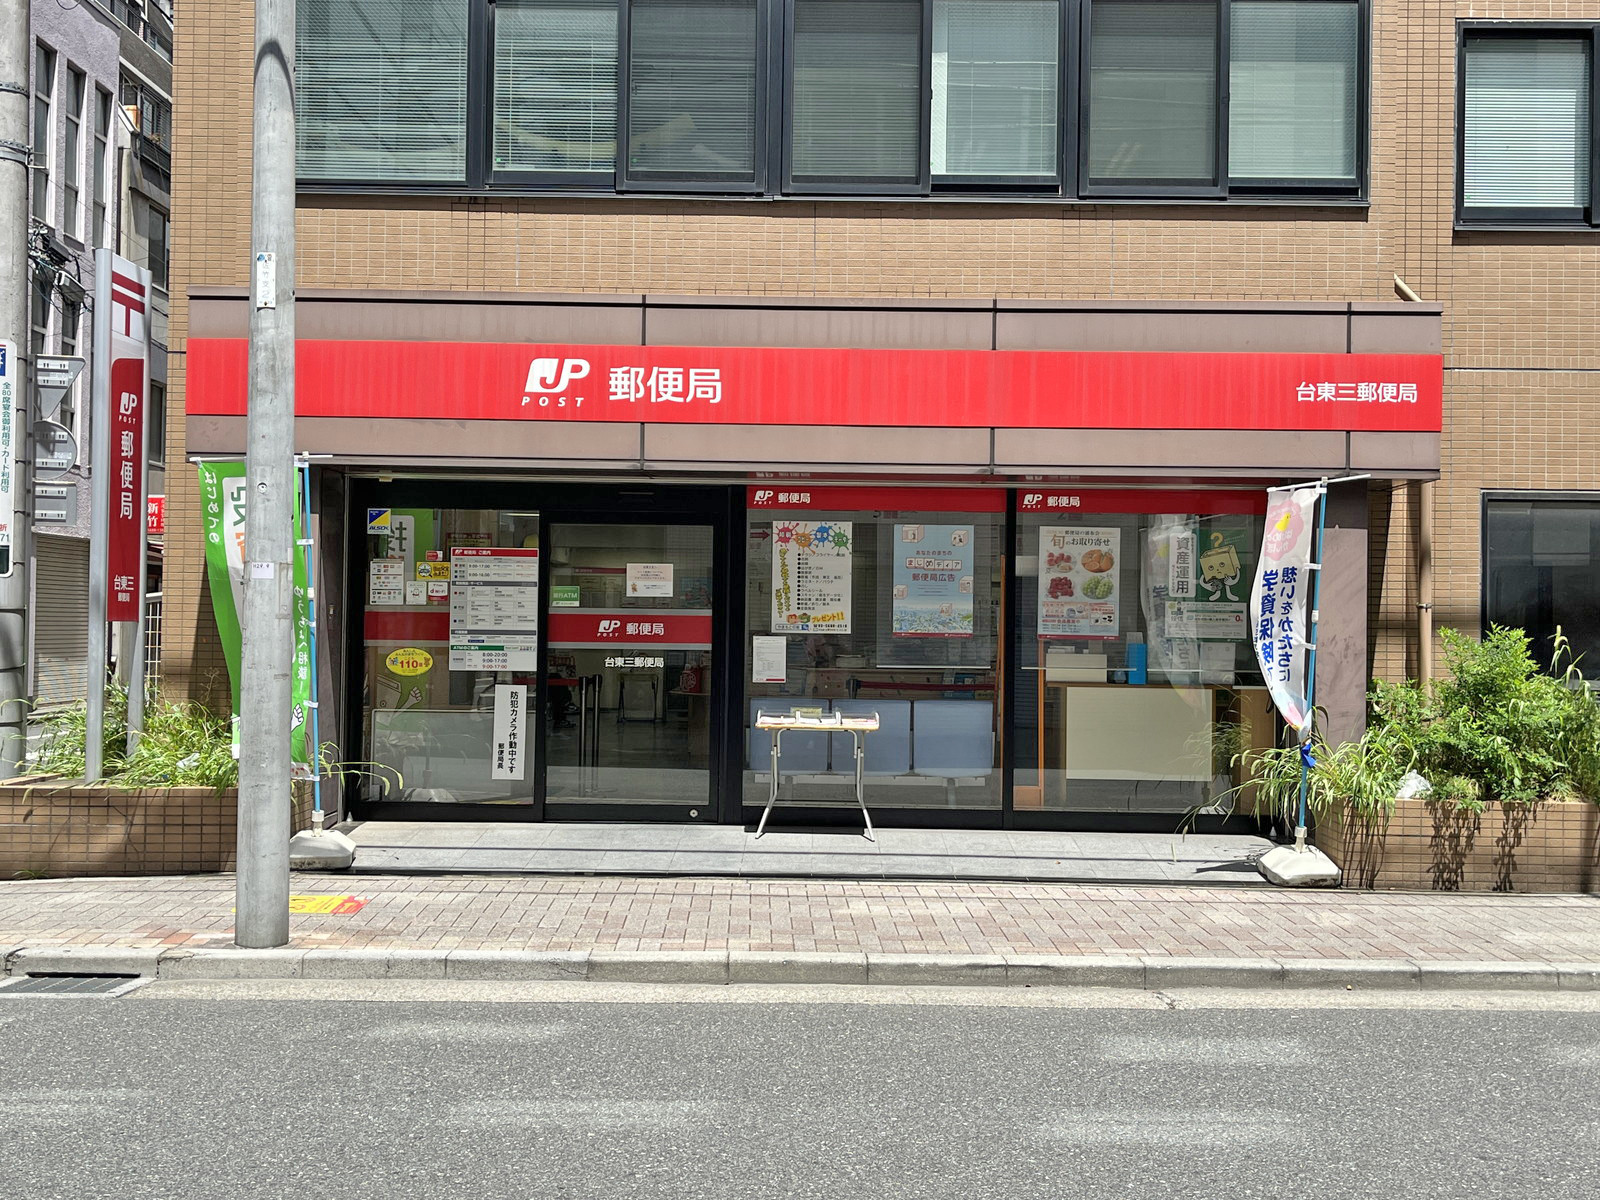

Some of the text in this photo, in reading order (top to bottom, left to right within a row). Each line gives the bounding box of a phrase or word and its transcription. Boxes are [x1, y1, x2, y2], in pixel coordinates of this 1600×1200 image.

[524, 358, 591, 393] JP
[608, 366, 723, 404] 郵便局
[1295, 381, 1418, 403] 台東三郵便局
[119, 391, 138, 415] JP
[521, 396, 585, 408] POST
[118, 415, 137, 425] POST
[120, 430, 135, 520] 郵便局
[777, 492, 812, 504] 郵便局
[1046, 495, 1081, 508] 郵便局
[1051, 535, 1111, 549] 旬のお取り寄せ
[1175, 536, 1190, 594] 資産運用
[113, 574, 135, 591] 台東三
[911, 573, 956, 582] 郵便局広告
[625, 622, 665, 636] 郵便局
[604, 656, 664, 668] 台東三郵便局
[508, 690, 519, 774] 防犯カメラ作動中です
[497, 742, 505, 770] 郵便局長
